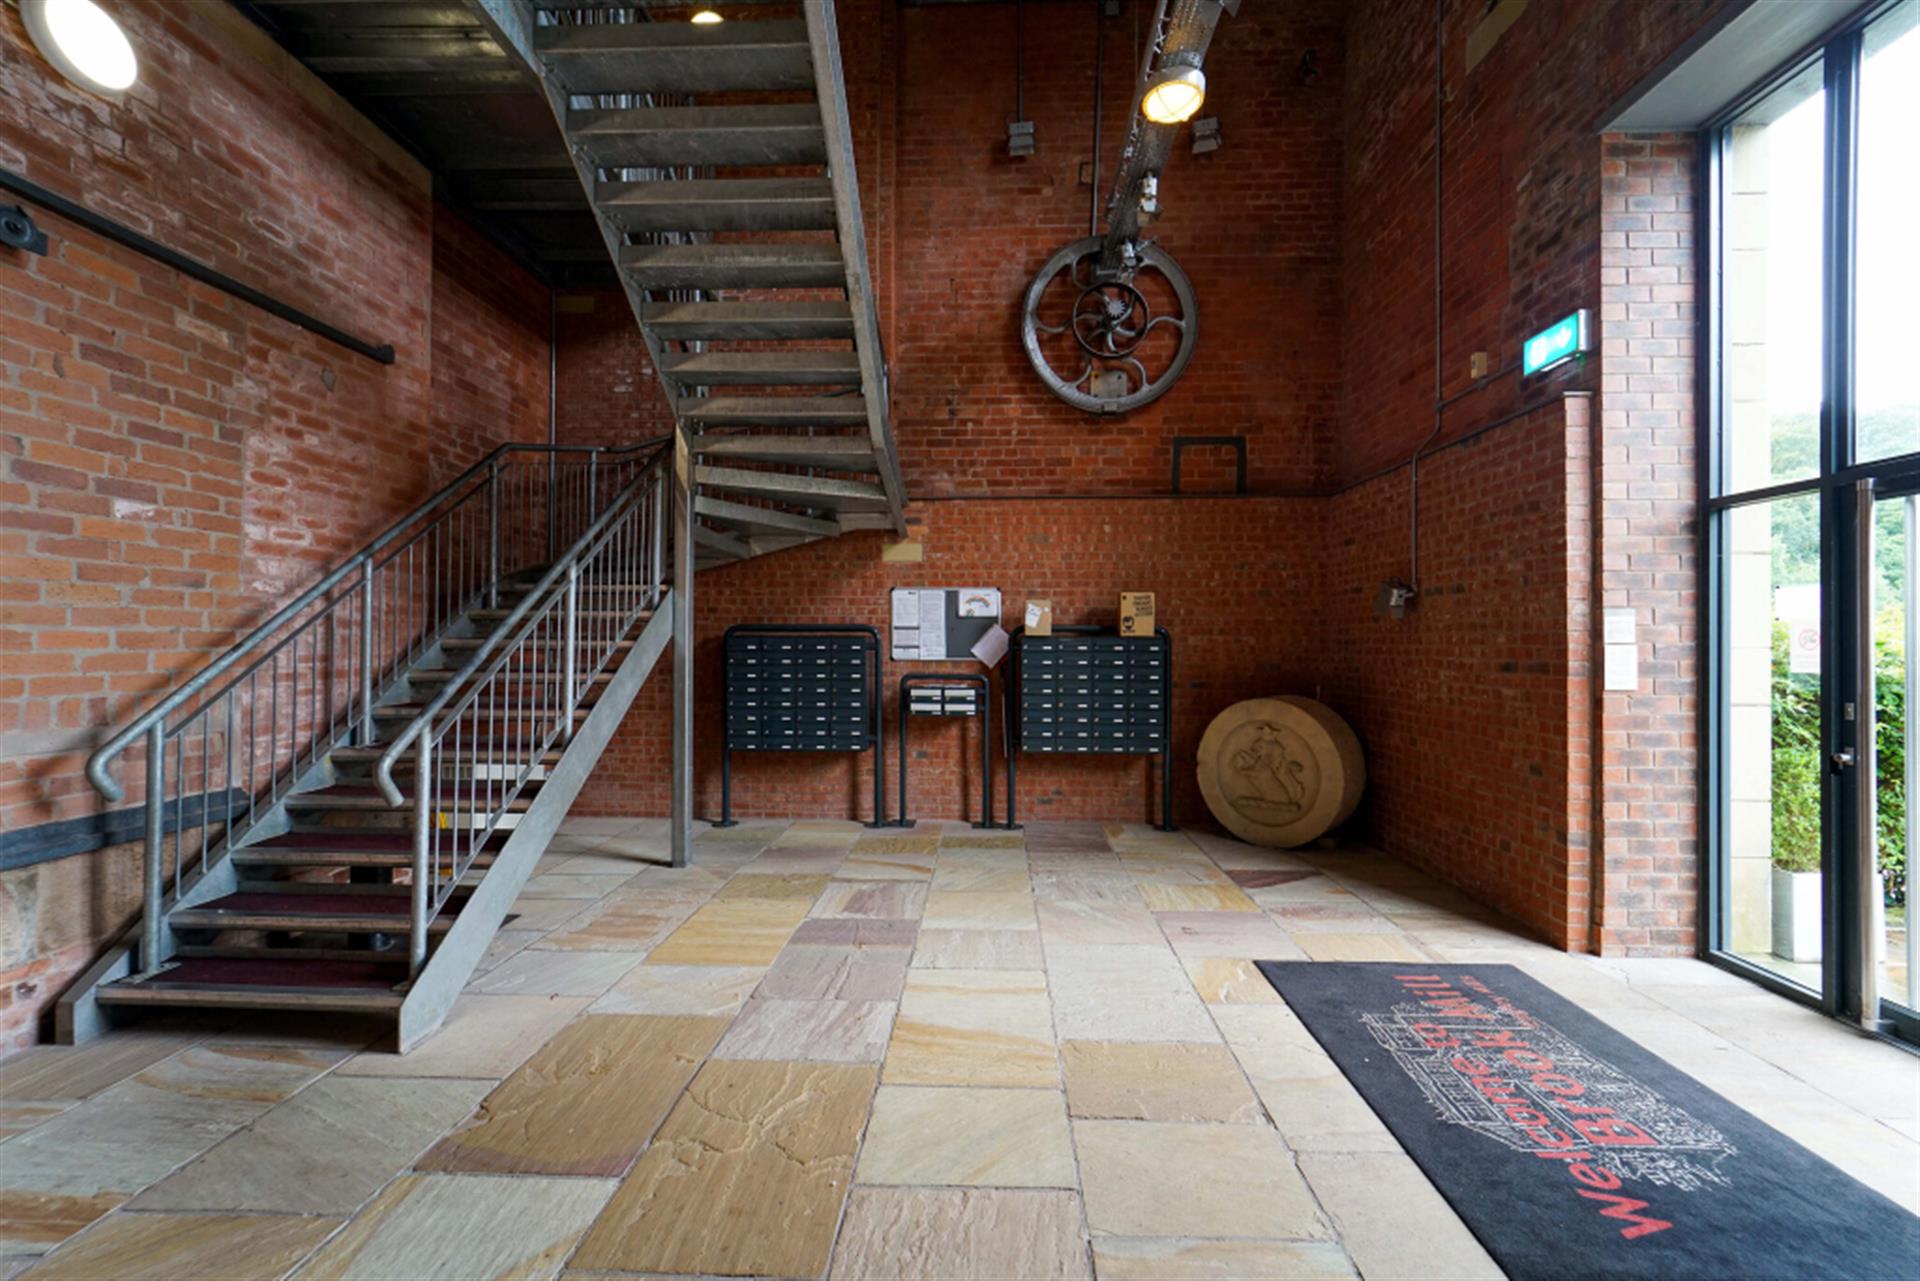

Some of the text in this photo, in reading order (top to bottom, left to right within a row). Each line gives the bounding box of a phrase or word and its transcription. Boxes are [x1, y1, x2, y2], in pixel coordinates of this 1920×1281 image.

[1391, 974, 1497, 1022] Mill
[1413, 1019, 1674, 1241] Welcome to
[1470, 1025, 1659, 1147] Brook
